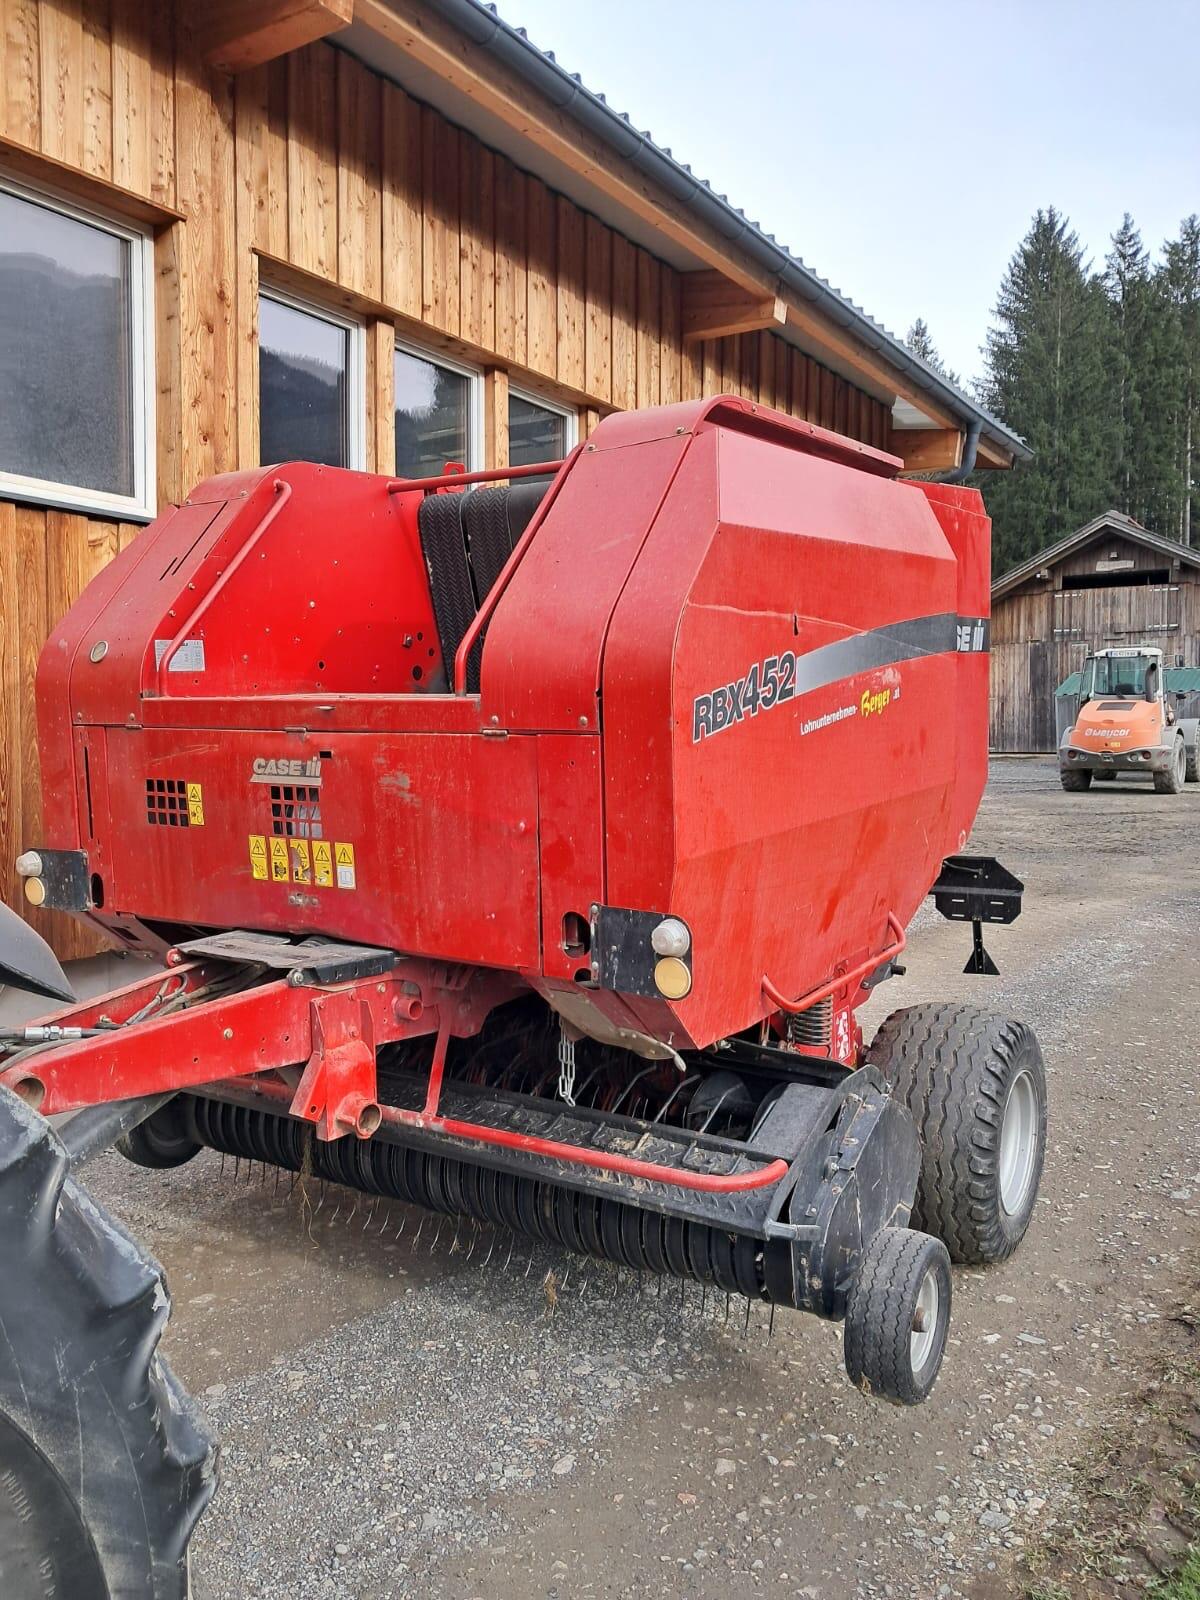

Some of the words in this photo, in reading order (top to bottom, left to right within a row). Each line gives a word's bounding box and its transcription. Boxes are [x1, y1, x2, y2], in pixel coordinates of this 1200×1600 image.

[693, 650, 796, 744] RBX452
[861, 689, 891, 718] Berger
[253, 757, 301, 777] CASE
